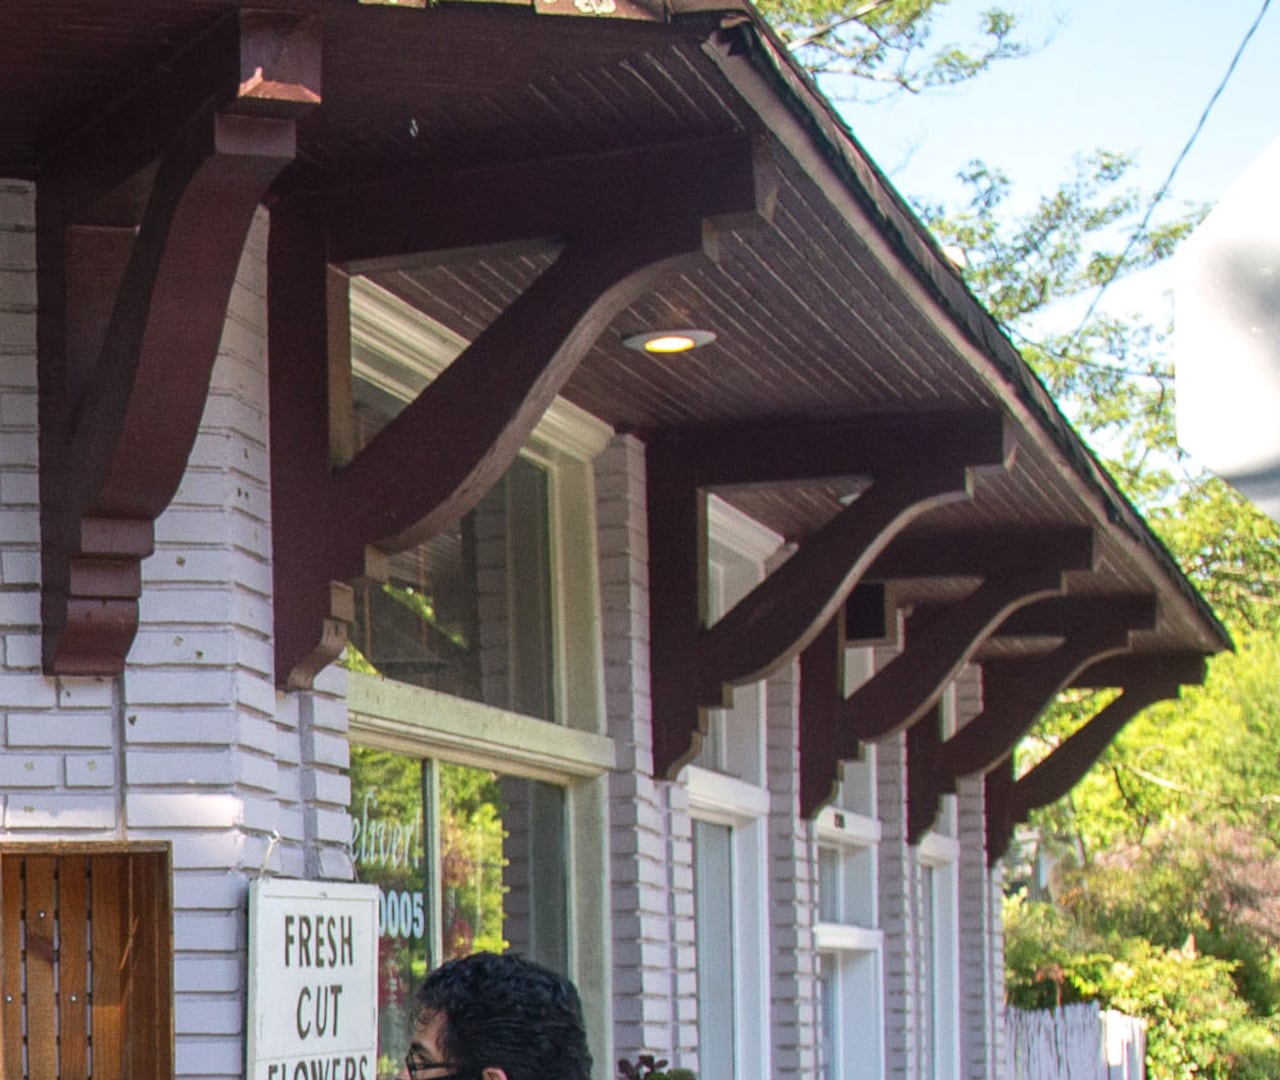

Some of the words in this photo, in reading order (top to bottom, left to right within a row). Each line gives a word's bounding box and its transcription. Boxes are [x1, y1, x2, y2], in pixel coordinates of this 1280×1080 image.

[347, 790, 420, 870] eliver!
[284, 915, 354, 968] FRESH
[296, 984, 343, 1040] CUT
